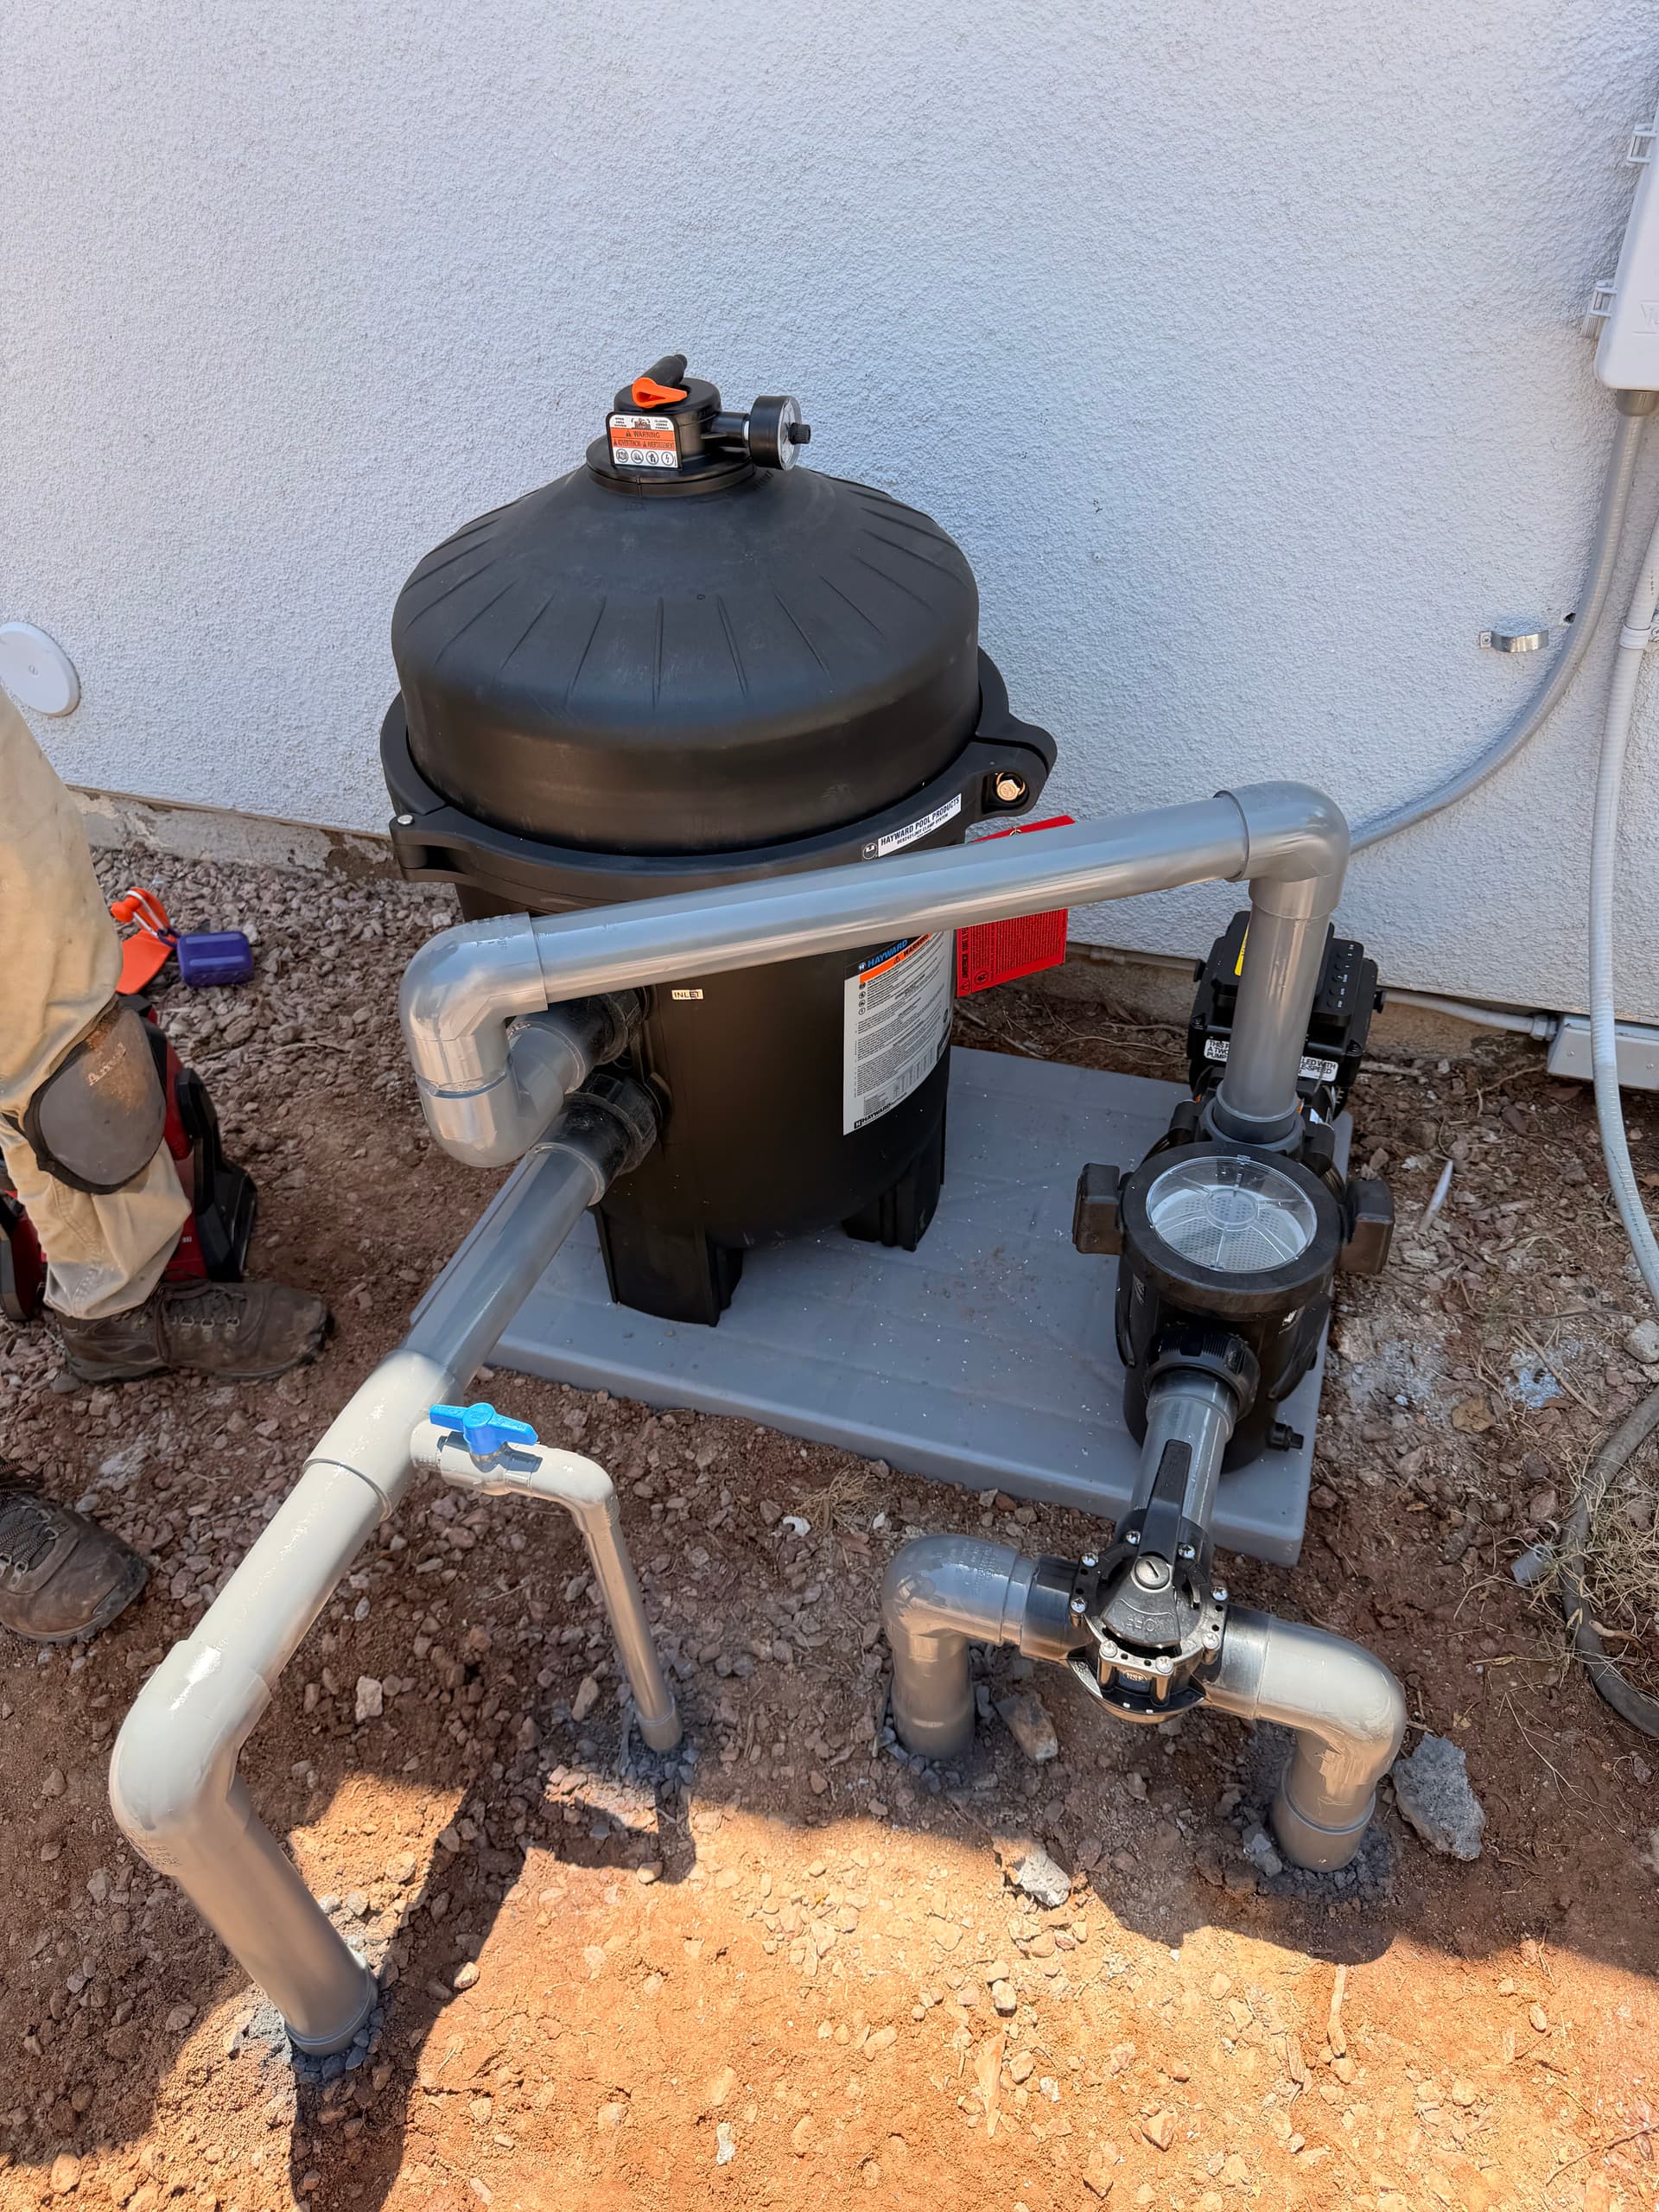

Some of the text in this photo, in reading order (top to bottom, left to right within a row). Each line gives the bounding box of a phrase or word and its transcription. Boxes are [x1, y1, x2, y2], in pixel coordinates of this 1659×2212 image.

[633, 430, 661, 439] WARNING
[880, 796, 960, 846] HAYWARD POOL PRODUCTS
[868, 939, 908, 968] HAYWARD
[903, 933, 929, 957] WARNING
[861, 1103, 891, 1122] HAYWARD
